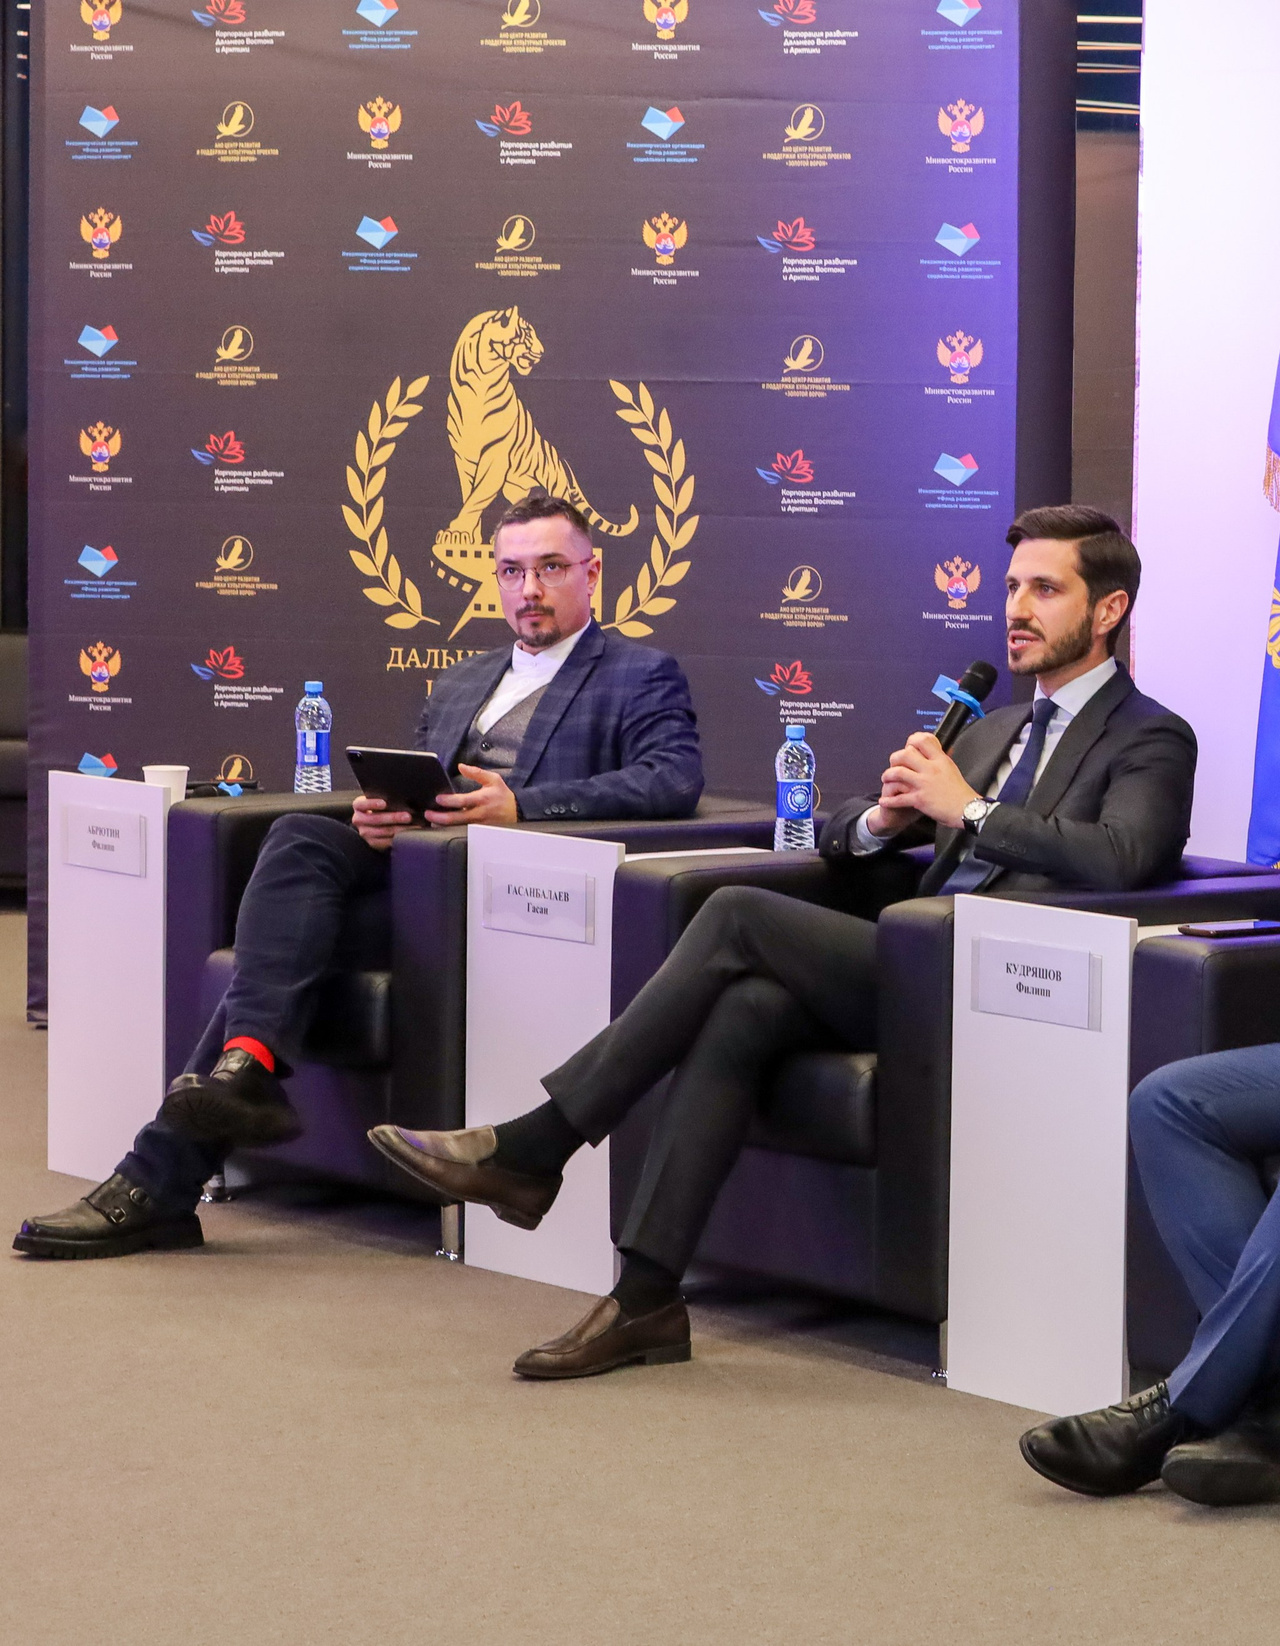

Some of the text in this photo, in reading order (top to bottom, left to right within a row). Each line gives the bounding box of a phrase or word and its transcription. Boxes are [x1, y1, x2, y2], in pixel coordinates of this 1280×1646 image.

[632, 43, 700, 52] Минвостокразвития
[654, 52, 677, 60] России
[368, 161, 391, 169] России
[926, 156, 996, 165] Минвостокразвития
[948, 165, 973, 173] России
[90, 270, 112, 278] России
[631, 268, 699, 277] Минвостокразвития
[653, 277, 677, 285] России
[925, 387, 995, 396] Минвостокразвития
[947, 396, 971, 404] России
[922, 612, 992, 622] Минвостокразвития
[945, 621, 969, 629] России
[88, 825, 120, 839] АБРЮТИН
[507, 884, 570, 902] ГАСАНБАЛАЕВ
[527, 902, 549, 915] Гасан
[1006, 962, 1062, 982] КУДРЯШОВ
[1016, 981, 1051, 998] Филипп
